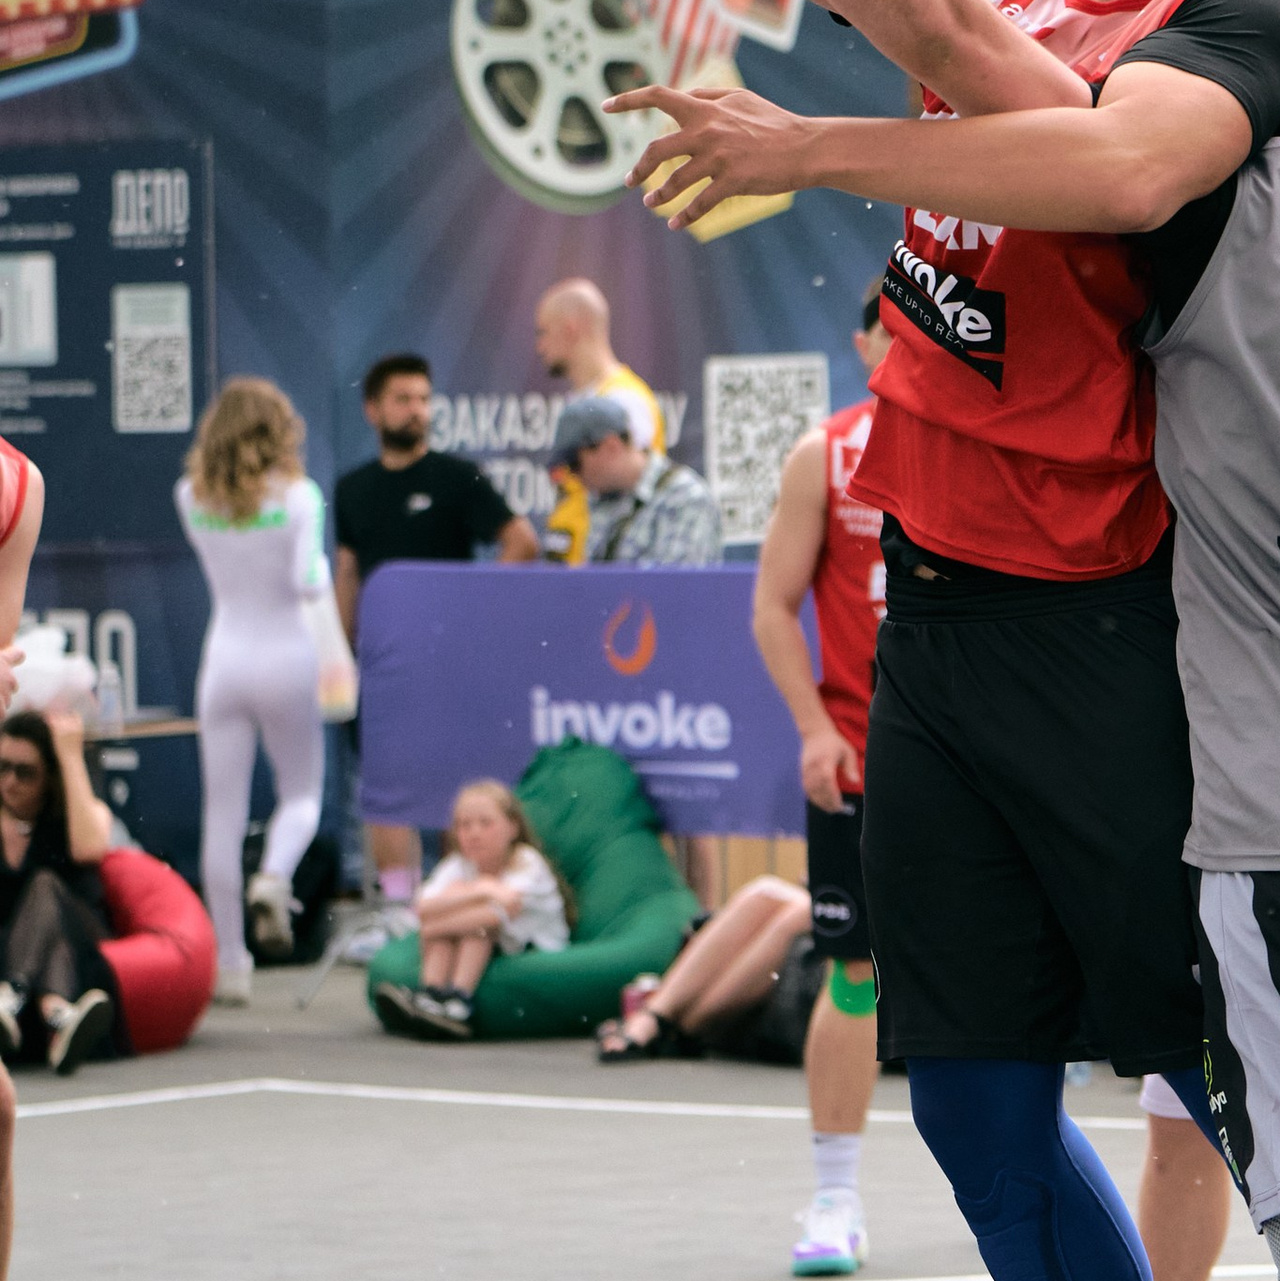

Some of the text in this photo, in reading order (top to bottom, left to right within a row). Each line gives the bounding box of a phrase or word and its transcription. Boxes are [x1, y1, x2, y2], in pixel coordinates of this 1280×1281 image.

[883, 276, 904, 298] AKE
[905, 294, 918, 309] UP
[919, 307, 932, 326] TO
[894, 239, 992, 342] voke
[430, 391, 563, 451] ЗАКАЗ
[531, 686, 732, 751] invoke
